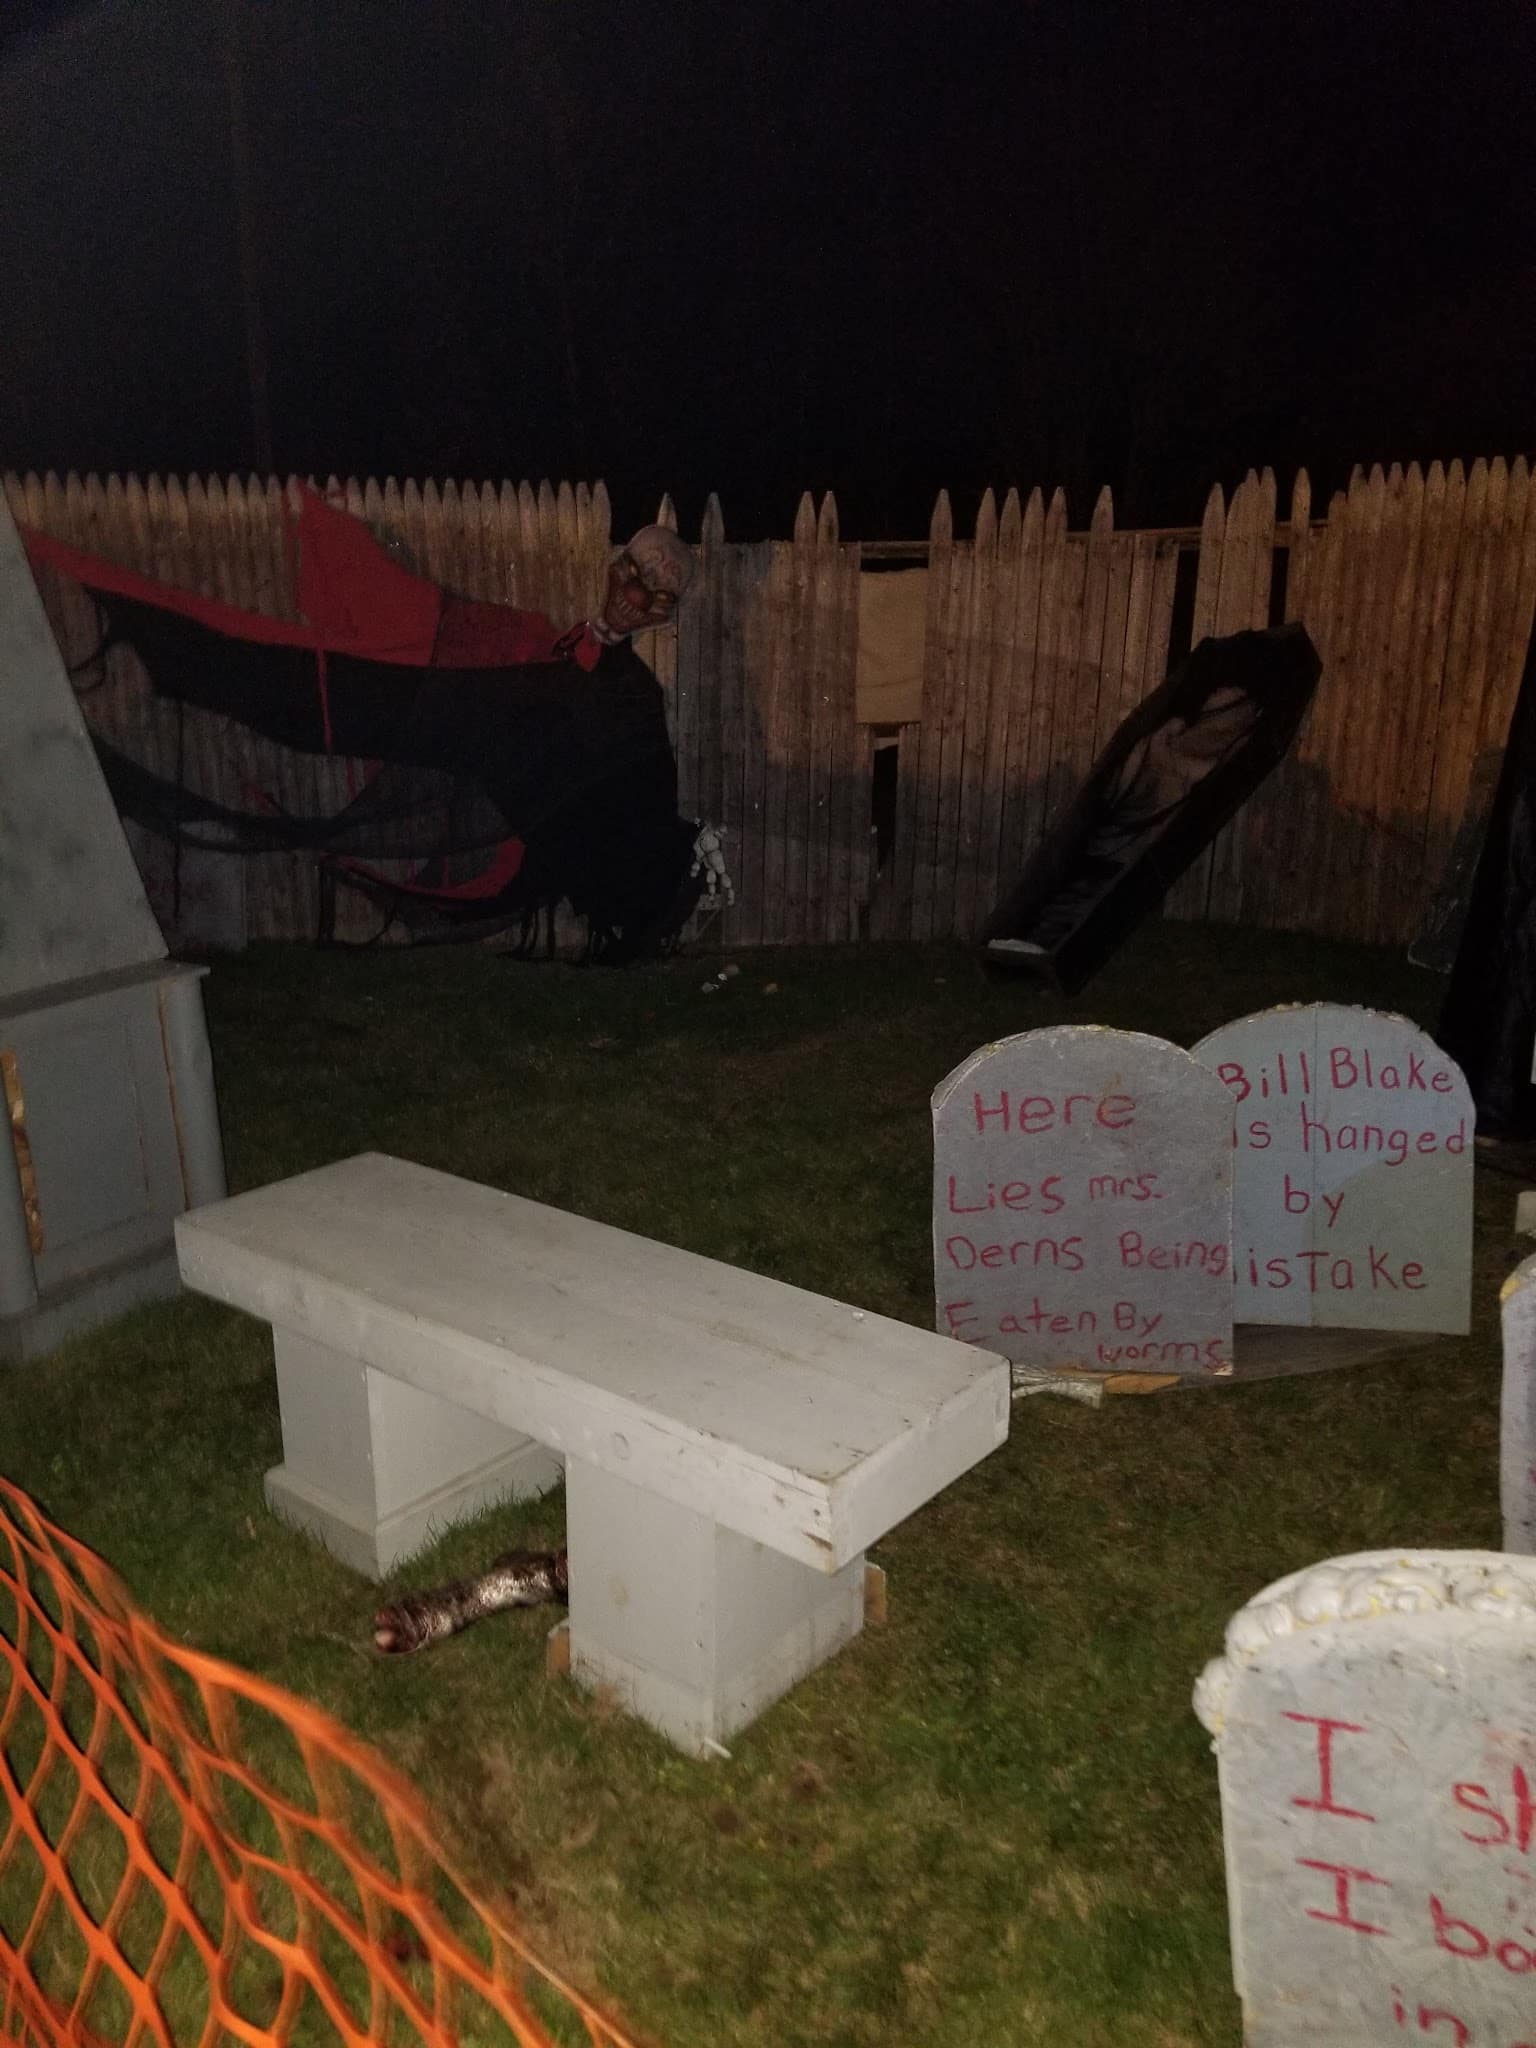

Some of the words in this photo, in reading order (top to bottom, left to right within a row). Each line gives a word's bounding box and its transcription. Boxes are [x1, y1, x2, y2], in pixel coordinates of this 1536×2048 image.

[1217, 1052, 1310, 1102] Bill
[1330, 1046, 1453, 1093] Blake
[974, 1087, 1136, 1134] Here
[1301, 1101, 1466, 1167] hanged
[948, 1175, 1066, 1214] Lies
[1284, 1173, 1345, 1228] by
[945, 1235, 1084, 1271] Derns
[1118, 1230, 1231, 1276] Being
[1232, 1244, 1428, 1293] isTake
[1113, 1301, 1164, 1338] By
[1281, 1711, 1375, 1822] I
